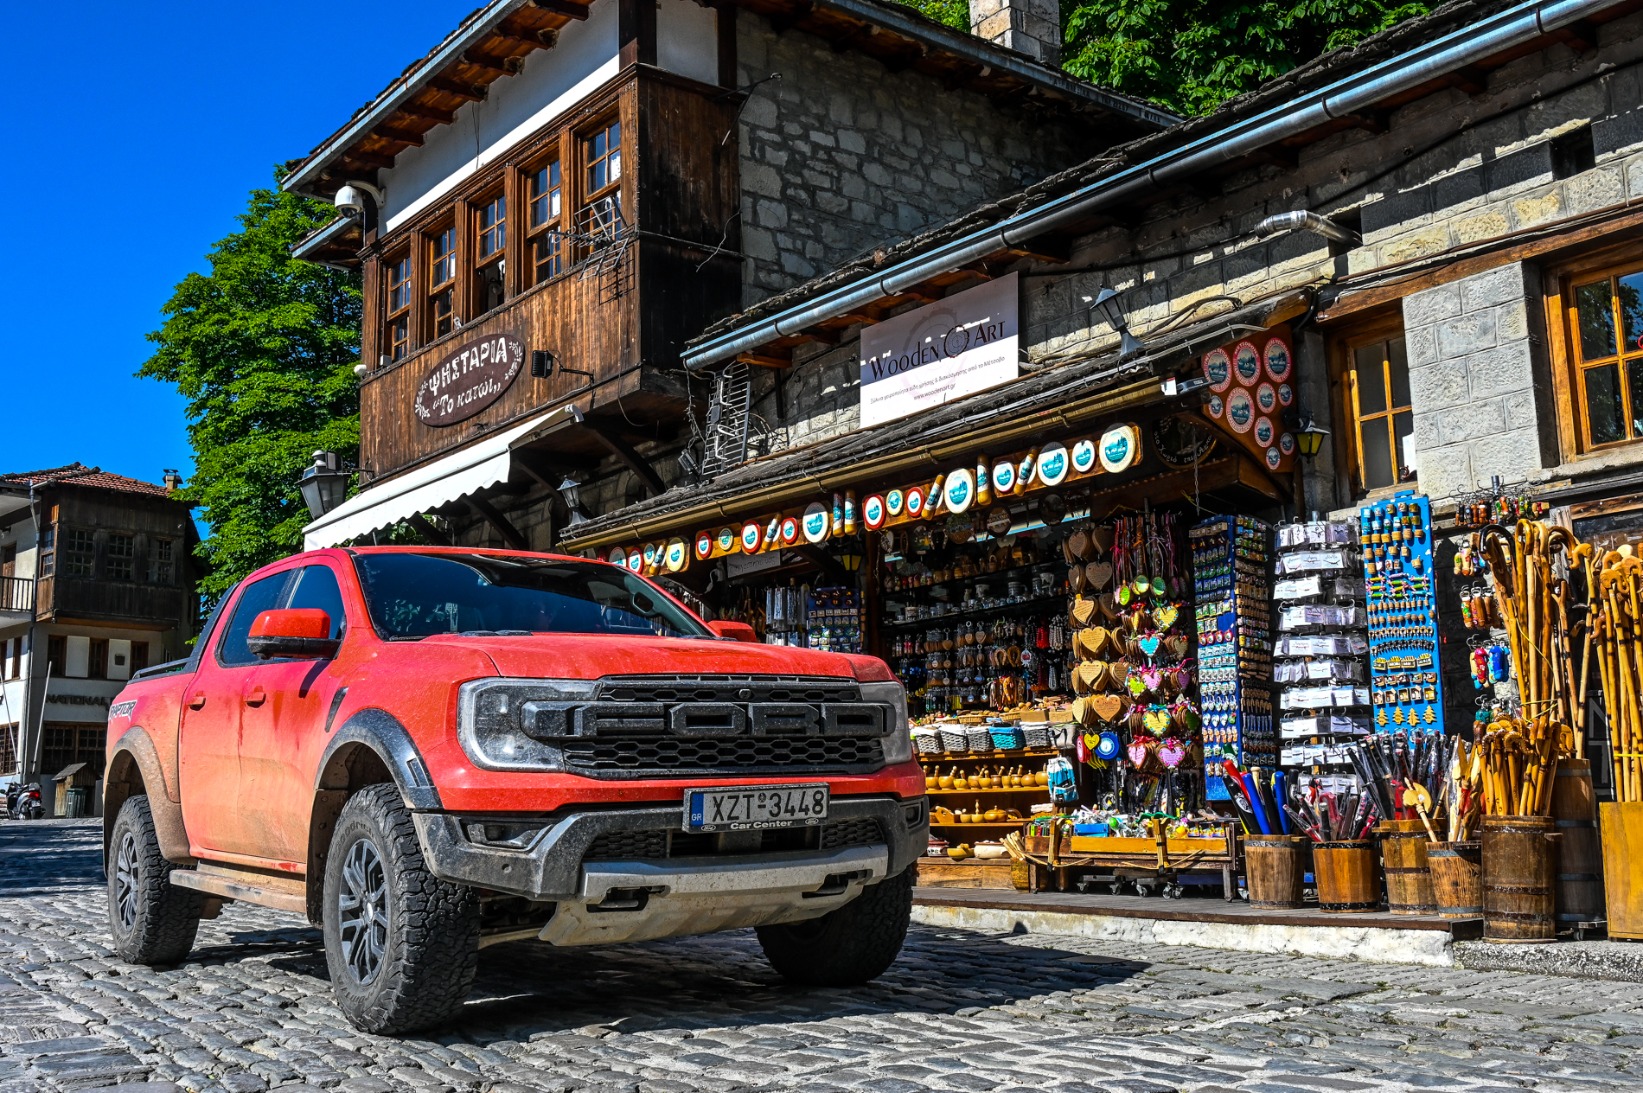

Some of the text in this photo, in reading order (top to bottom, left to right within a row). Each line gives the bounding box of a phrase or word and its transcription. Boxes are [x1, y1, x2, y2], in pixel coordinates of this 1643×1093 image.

[429, 337, 508, 396] ΨΗΣΤΑΡΙΑ
[46, 693, 106, 707] NATIONAL
[109, 700, 137, 720] RAPTOR
[574, 702, 887, 738] FORD
[691, 813, 702, 821] GR
[730, 822, 750, 830] Car
[753, 821, 793, 829] Center
